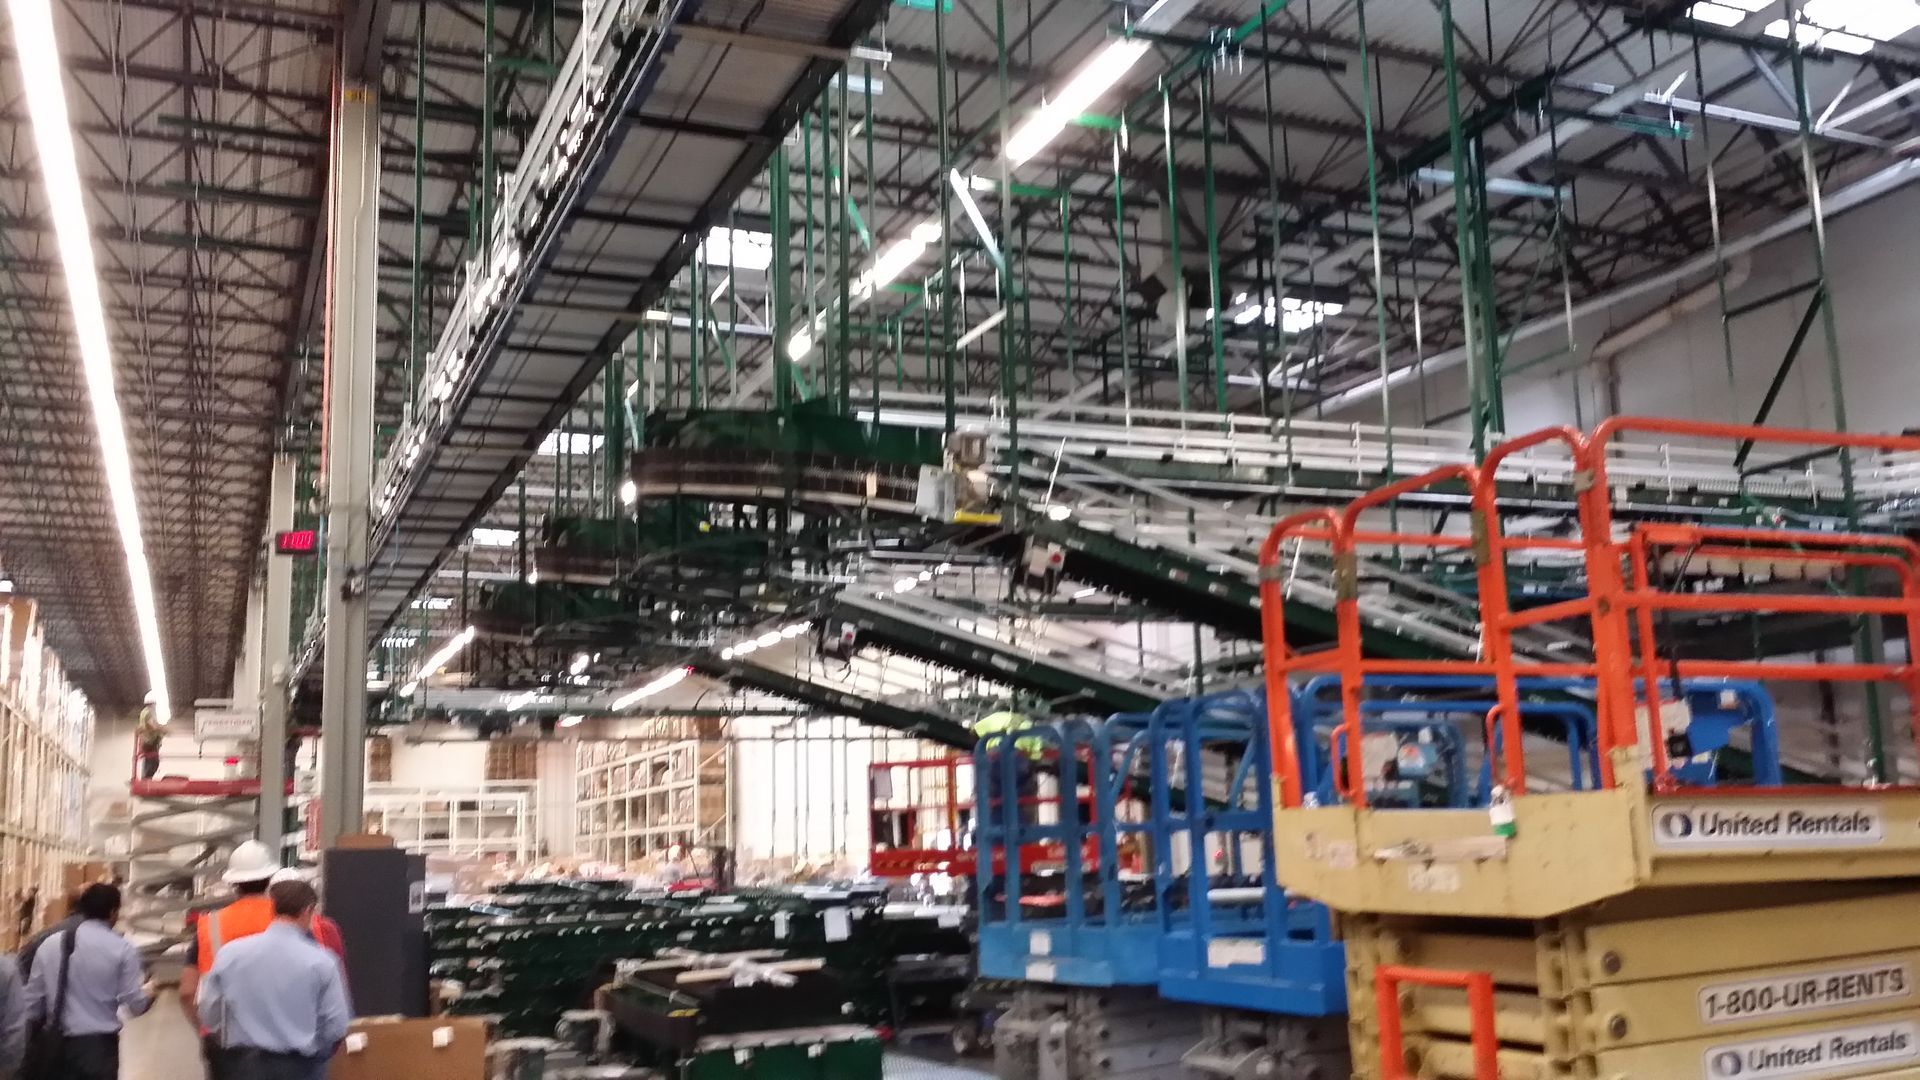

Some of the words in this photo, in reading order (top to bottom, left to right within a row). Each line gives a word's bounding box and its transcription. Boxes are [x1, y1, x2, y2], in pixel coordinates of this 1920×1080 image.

[1700, 811, 1779, 836] United
[1787, 809, 1871, 833] Rentals
[1705, 967, 1905, 1018] 1-800-UR-RENTS
[1748, 1041, 1822, 1071] United
[1829, 1029, 1908, 1057] Rentals
